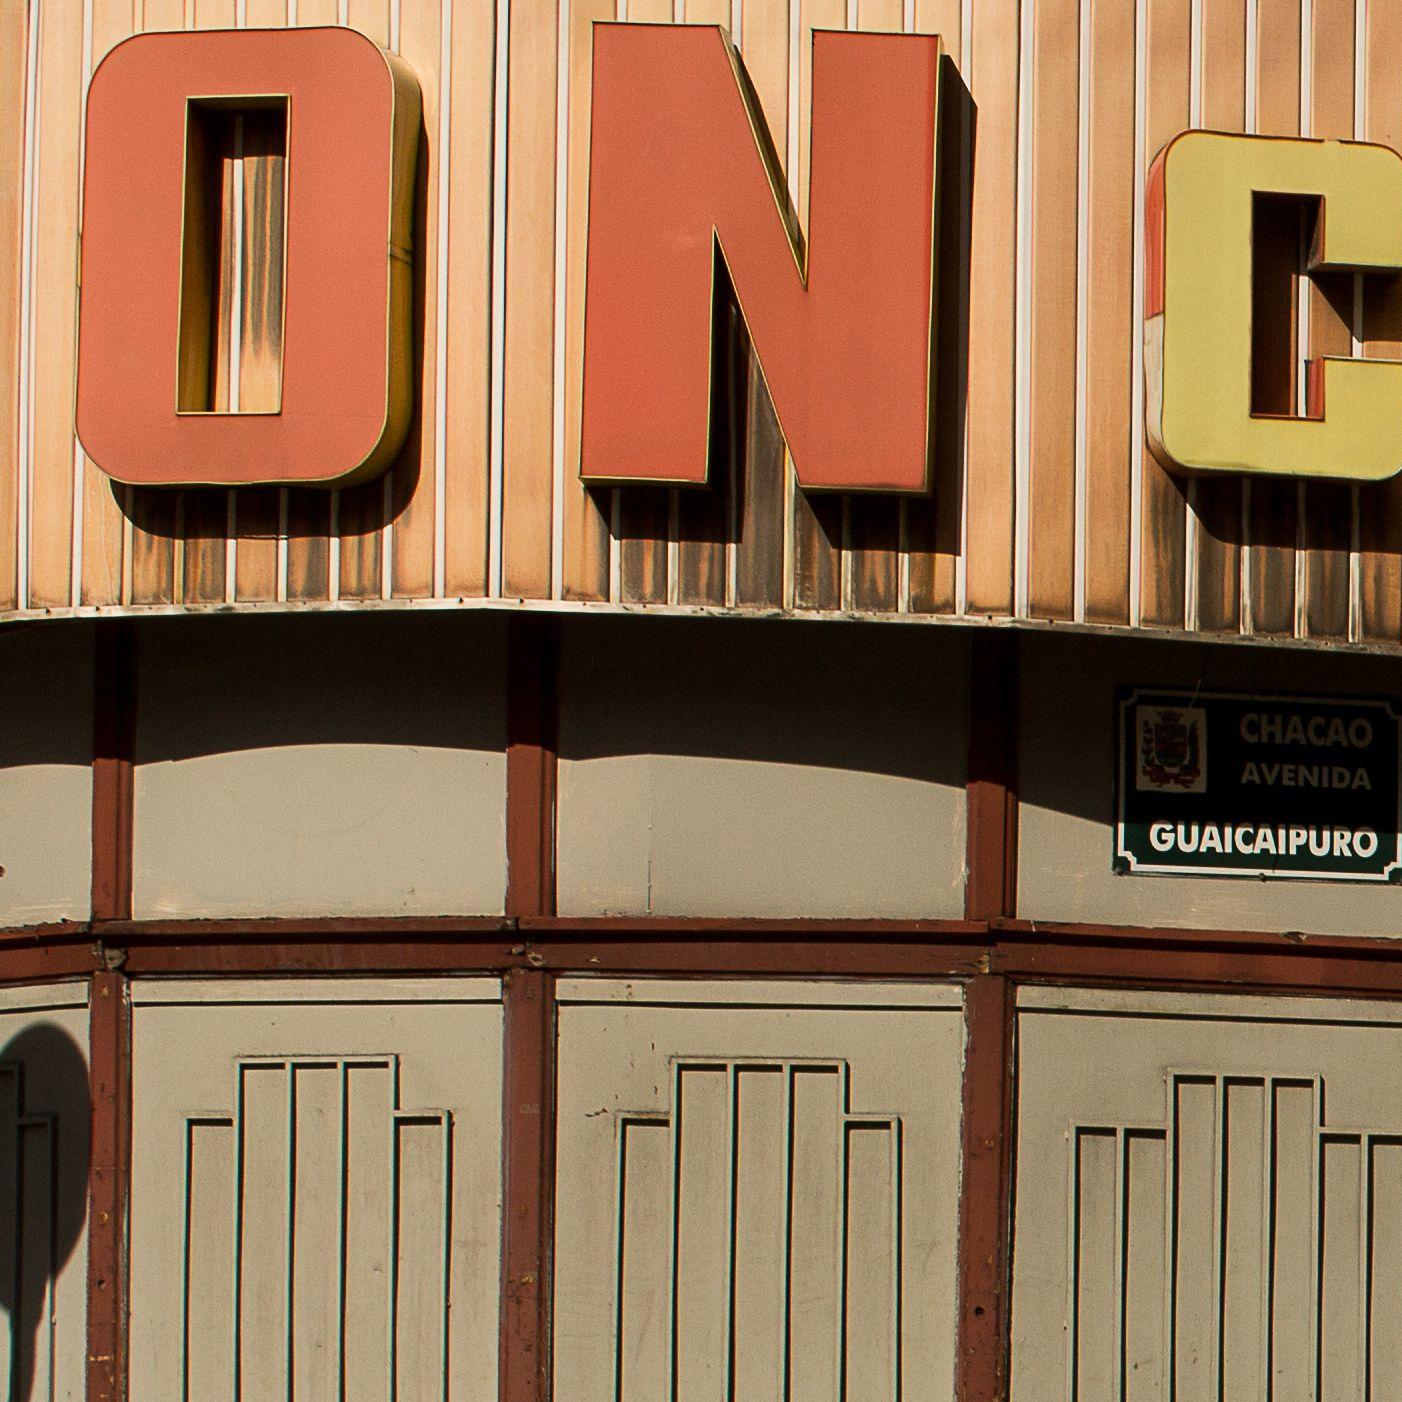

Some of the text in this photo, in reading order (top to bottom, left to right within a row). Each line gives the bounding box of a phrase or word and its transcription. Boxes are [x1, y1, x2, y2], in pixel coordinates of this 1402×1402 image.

[75, 20, 942, 497] ON
[1240, 712, 1374, 749] CHACAO
[1240, 761, 1373, 791] AVENIDA
[1148, 819, 1379, 858] GUAICAIPURO
